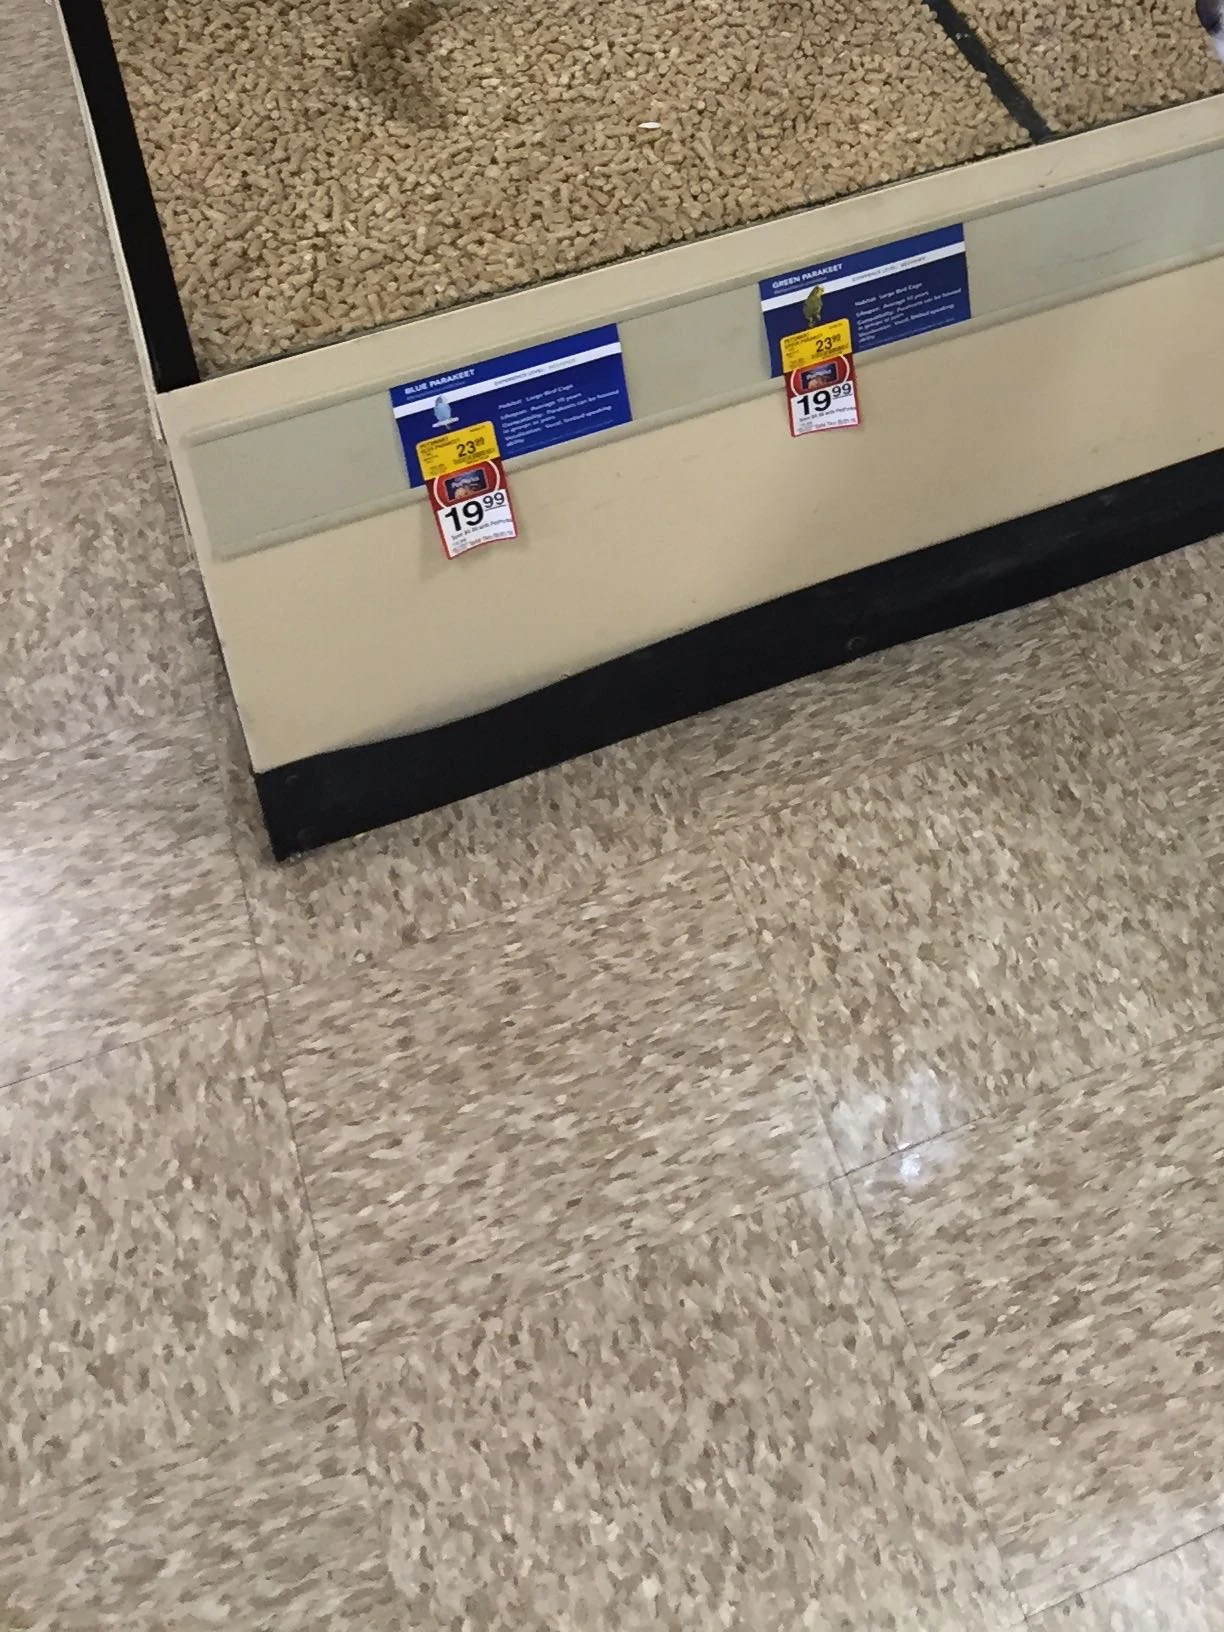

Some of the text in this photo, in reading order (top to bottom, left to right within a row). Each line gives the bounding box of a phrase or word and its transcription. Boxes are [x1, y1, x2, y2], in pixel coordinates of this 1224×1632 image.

[772, 276, 800, 289] GREEN
[801, 263, 843, 280] PARAKEET
[404, 382, 428, 395] BLUE
[429, 368, 475, 387] PARAKEET
